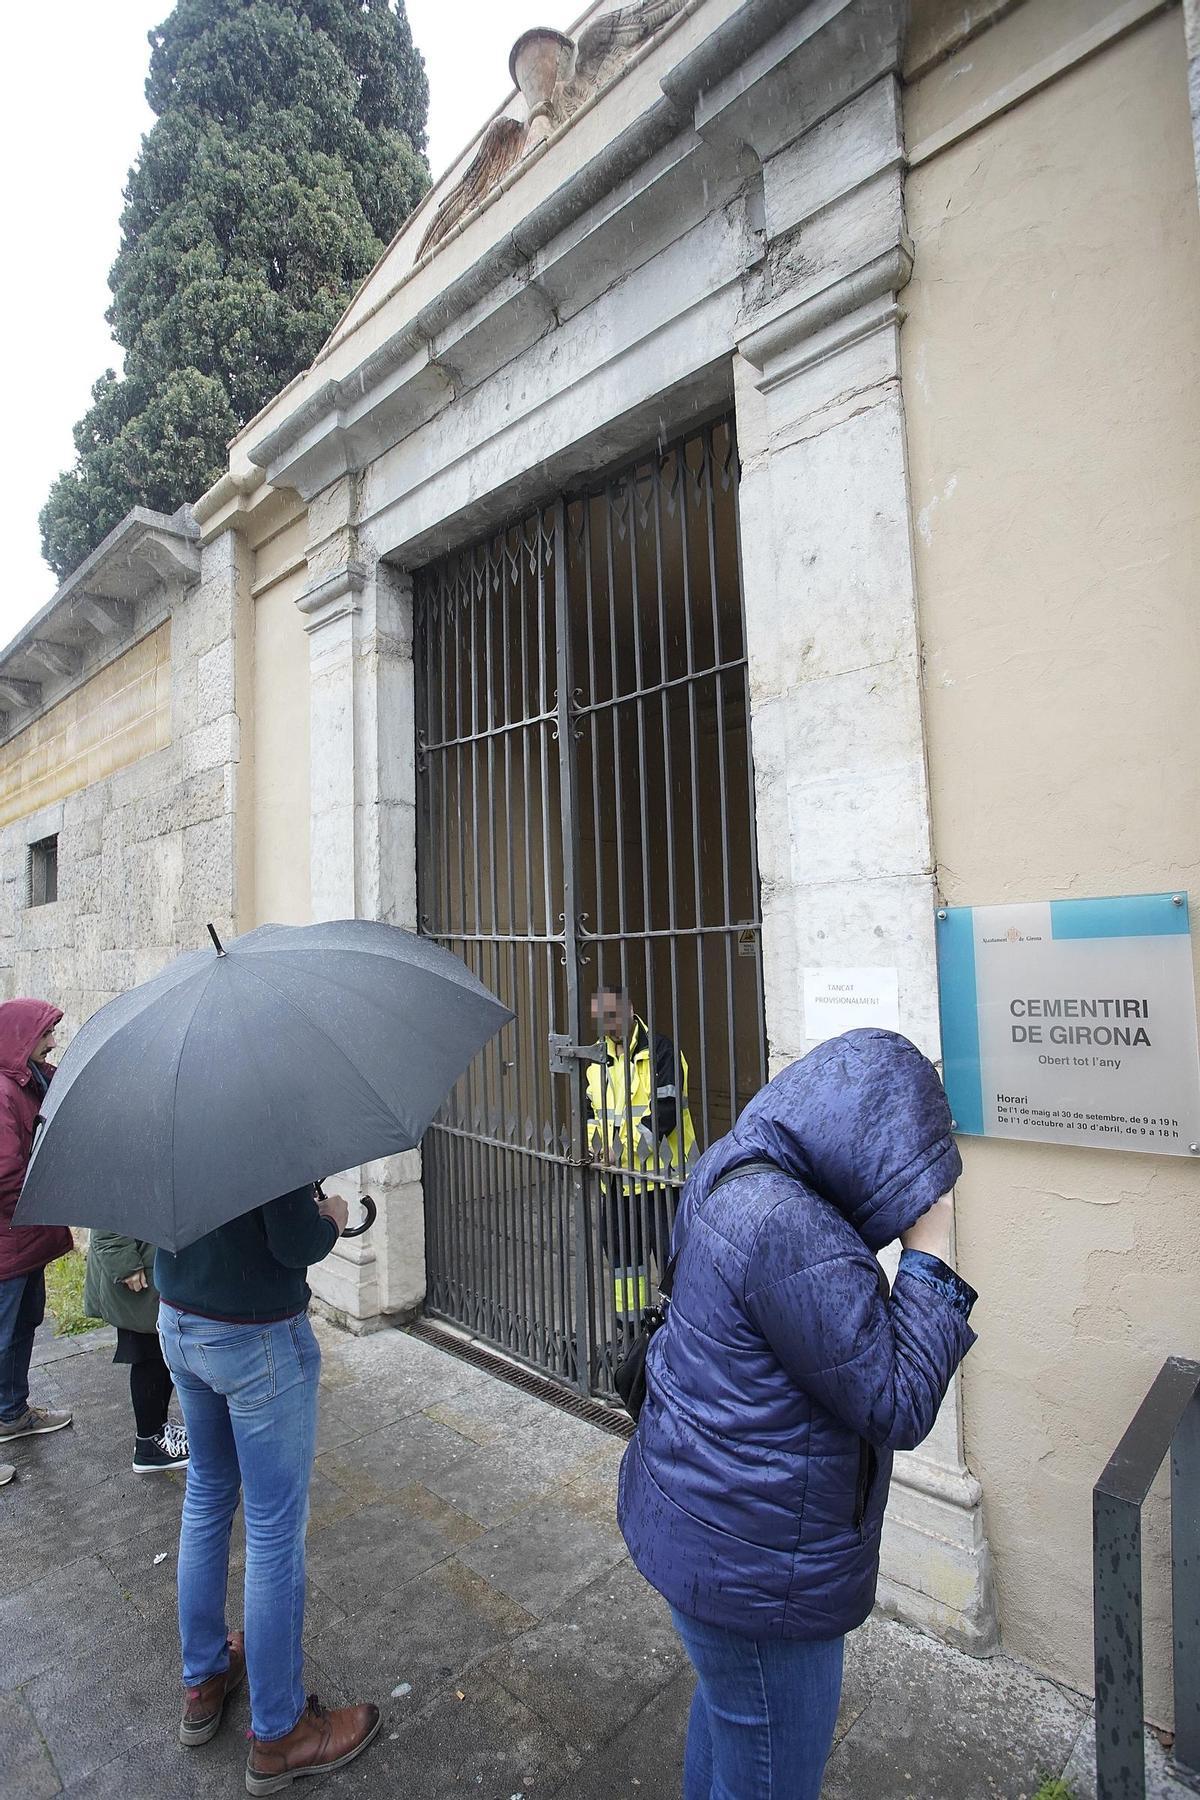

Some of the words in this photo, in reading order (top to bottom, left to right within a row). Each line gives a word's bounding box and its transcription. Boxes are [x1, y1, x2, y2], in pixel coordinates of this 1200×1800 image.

[827, 984, 855, 992] TANCAT
[814, 996, 880, 1005] PROVISIONALMENT
[1009, 999, 1150, 1019] CEMENTIRI
[1011, 1025, 1043, 1044] DE
[1049, 1025, 1152, 1047] GIRONA
[1038, 1054, 1070, 1066] Obert
[1073, 1055, 1090, 1067] tot
[1092, 1056, 1122, 1070] l'any
[996, 1093, 1028, 1104] Horari
[997, 1105, 1008, 1113] De
[1031, 1109, 1051, 1118] maig
[1052, 1110, 1060, 1118] al
[1061, 1110, 1072, 1118] 30
[1073, 1111, 1084, 1119] de
[1085, 1113, 1128, 1123] setembre,
[1129, 1116, 1141, 1124] de
[1142, 1116, 1149, 1124] 9
[1159, 1118, 1170, 1126] 19
[1172, 1119, 1178, 1127] h
[998, 1115, 1009, 1123] De
[1023, 1118, 1064, 1128] d'octubre
[1066, 1121, 1075, 1129] al
[1076, 1122, 1088, 1130] 30
[1090, 1123, 1123, 1134] d'abril,
[1125, 1126, 1138, 1135] de
[1140, 1127, 1146, 1135] 9
[1158, 1129, 1170, 1137] 18
[1172, 1130, 1179, 1138] h
